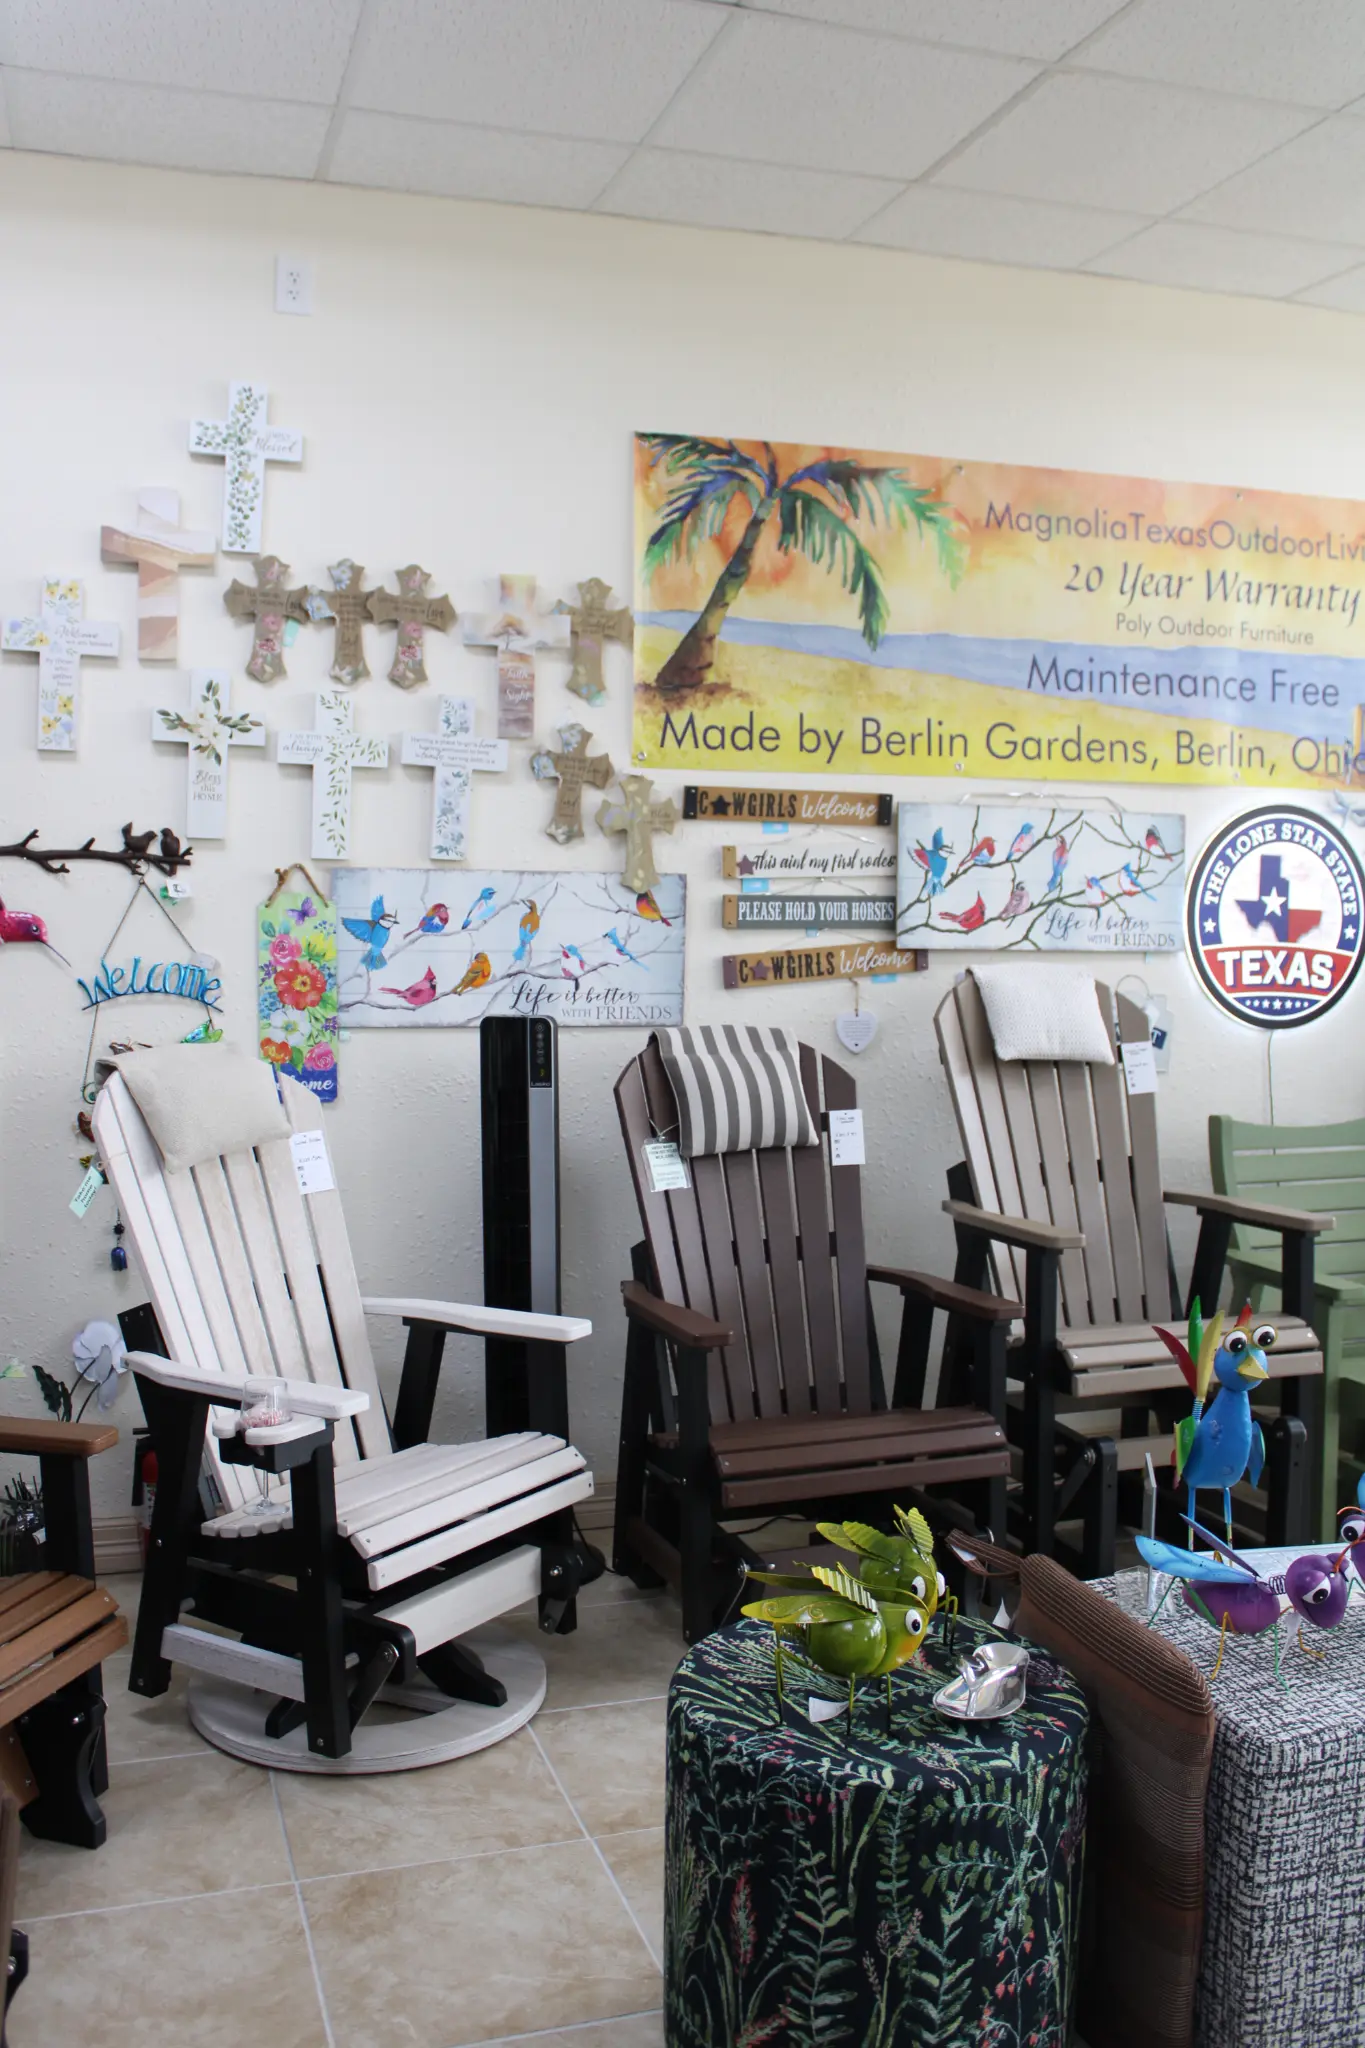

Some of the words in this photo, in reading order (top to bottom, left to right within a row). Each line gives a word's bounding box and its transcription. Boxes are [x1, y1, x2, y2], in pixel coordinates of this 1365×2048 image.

[1064, 564, 1104, 592] 20
[1119, 561, 1193, 608] Year
[1205, 568, 1361, 627] Warranty
[1116, 612, 1151, 640] Poly
[1158, 615, 1234, 639] Outdoor
[1240, 621, 1314, 645] Furniture
[1027, 655, 1257, 702] Maintenance
[1271, 668, 1340, 707] Free
[660, 711, 781, 751] Made
[799, 712, 844, 764] by
[862, 717, 968, 757] Berlin
[986, 722, 1159, 771] Gardens,
[1176, 729, 1277, 776] Berlin,
[801, 793, 878, 821] Welcome
[753, 849, 777, 869] This
[808, 853, 830, 873] my
[831, 848, 857, 872] first
[859, 848, 897, 868] rodeo
[1204, 858, 1231, 905] THE
[1227, 822, 1277, 864] LONE
[1280, 822, 1327, 856] STAR
[1325, 850, 1358, 916] STATE
[738, 901, 783, 921] PLEASE
[785, 901, 816, 921] HOLD
[819, 901, 849, 921] YOUR
[851, 901, 895, 921] HORSES
[1044, 907, 1087, 941] Life
[1089, 918, 1101, 931] is
[1106, 916, 1150, 932] better
[1087, 934, 1111, 944] WITH
[1114, 933, 1176, 947] FRIENDS
[840, 947, 914, 974] Welcome
[1217, 949, 1334, 989] TEXAS
[509, 979, 562, 1016] Life
[565, 988, 581, 1005] is
[586, 986, 640, 1005] better
[562, 1008, 592, 1018] WITH
[596, 1005, 673, 1020] FRIENDS
